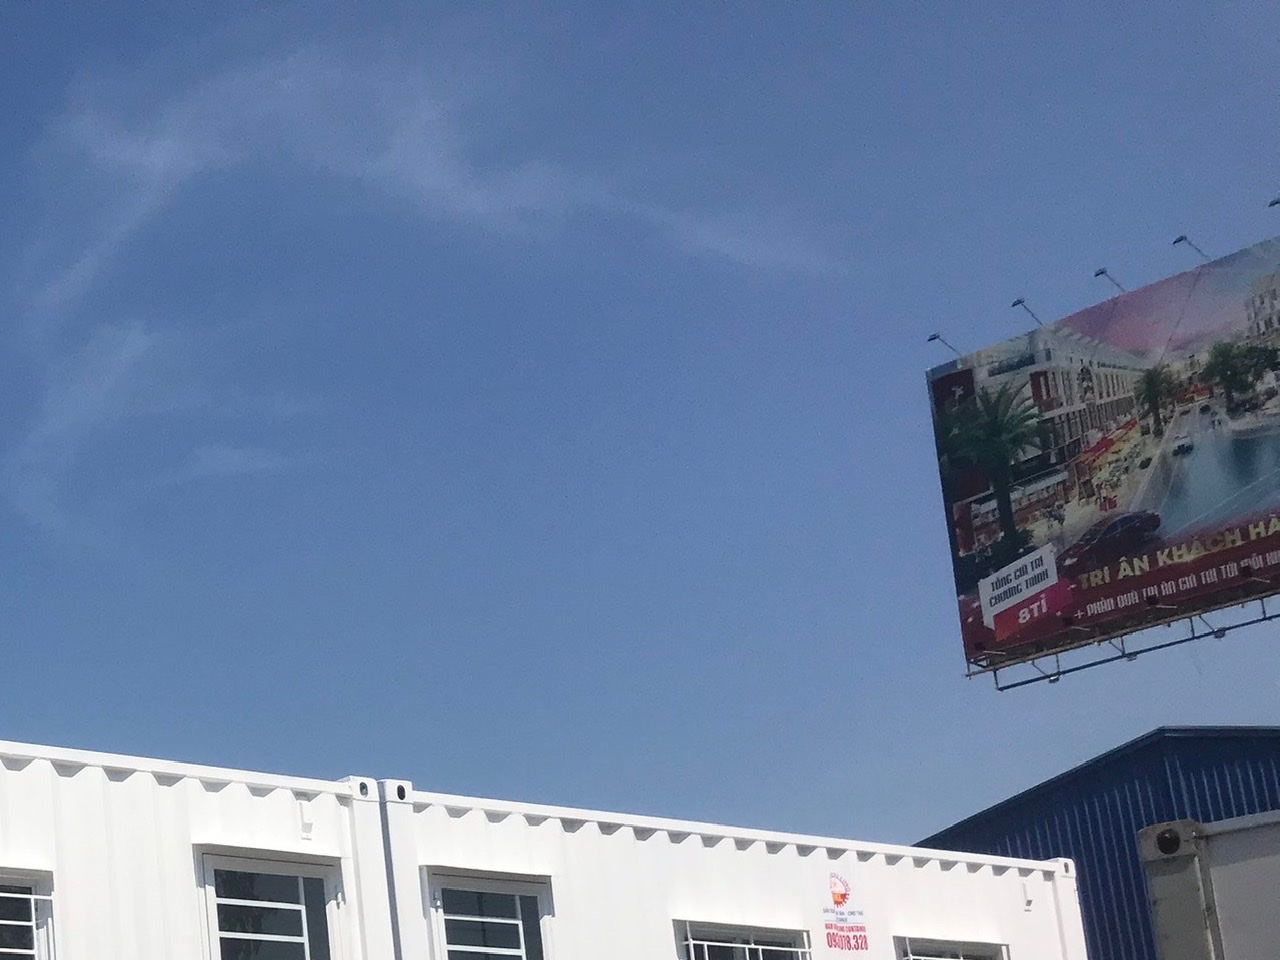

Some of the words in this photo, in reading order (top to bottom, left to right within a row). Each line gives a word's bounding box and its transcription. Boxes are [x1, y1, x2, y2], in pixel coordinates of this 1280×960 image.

[1078, 566, 1110, 590] TRI
[1117, 554, 1150, 580] ÂN
[1157, 527, 1242, 567] KHÁCH
